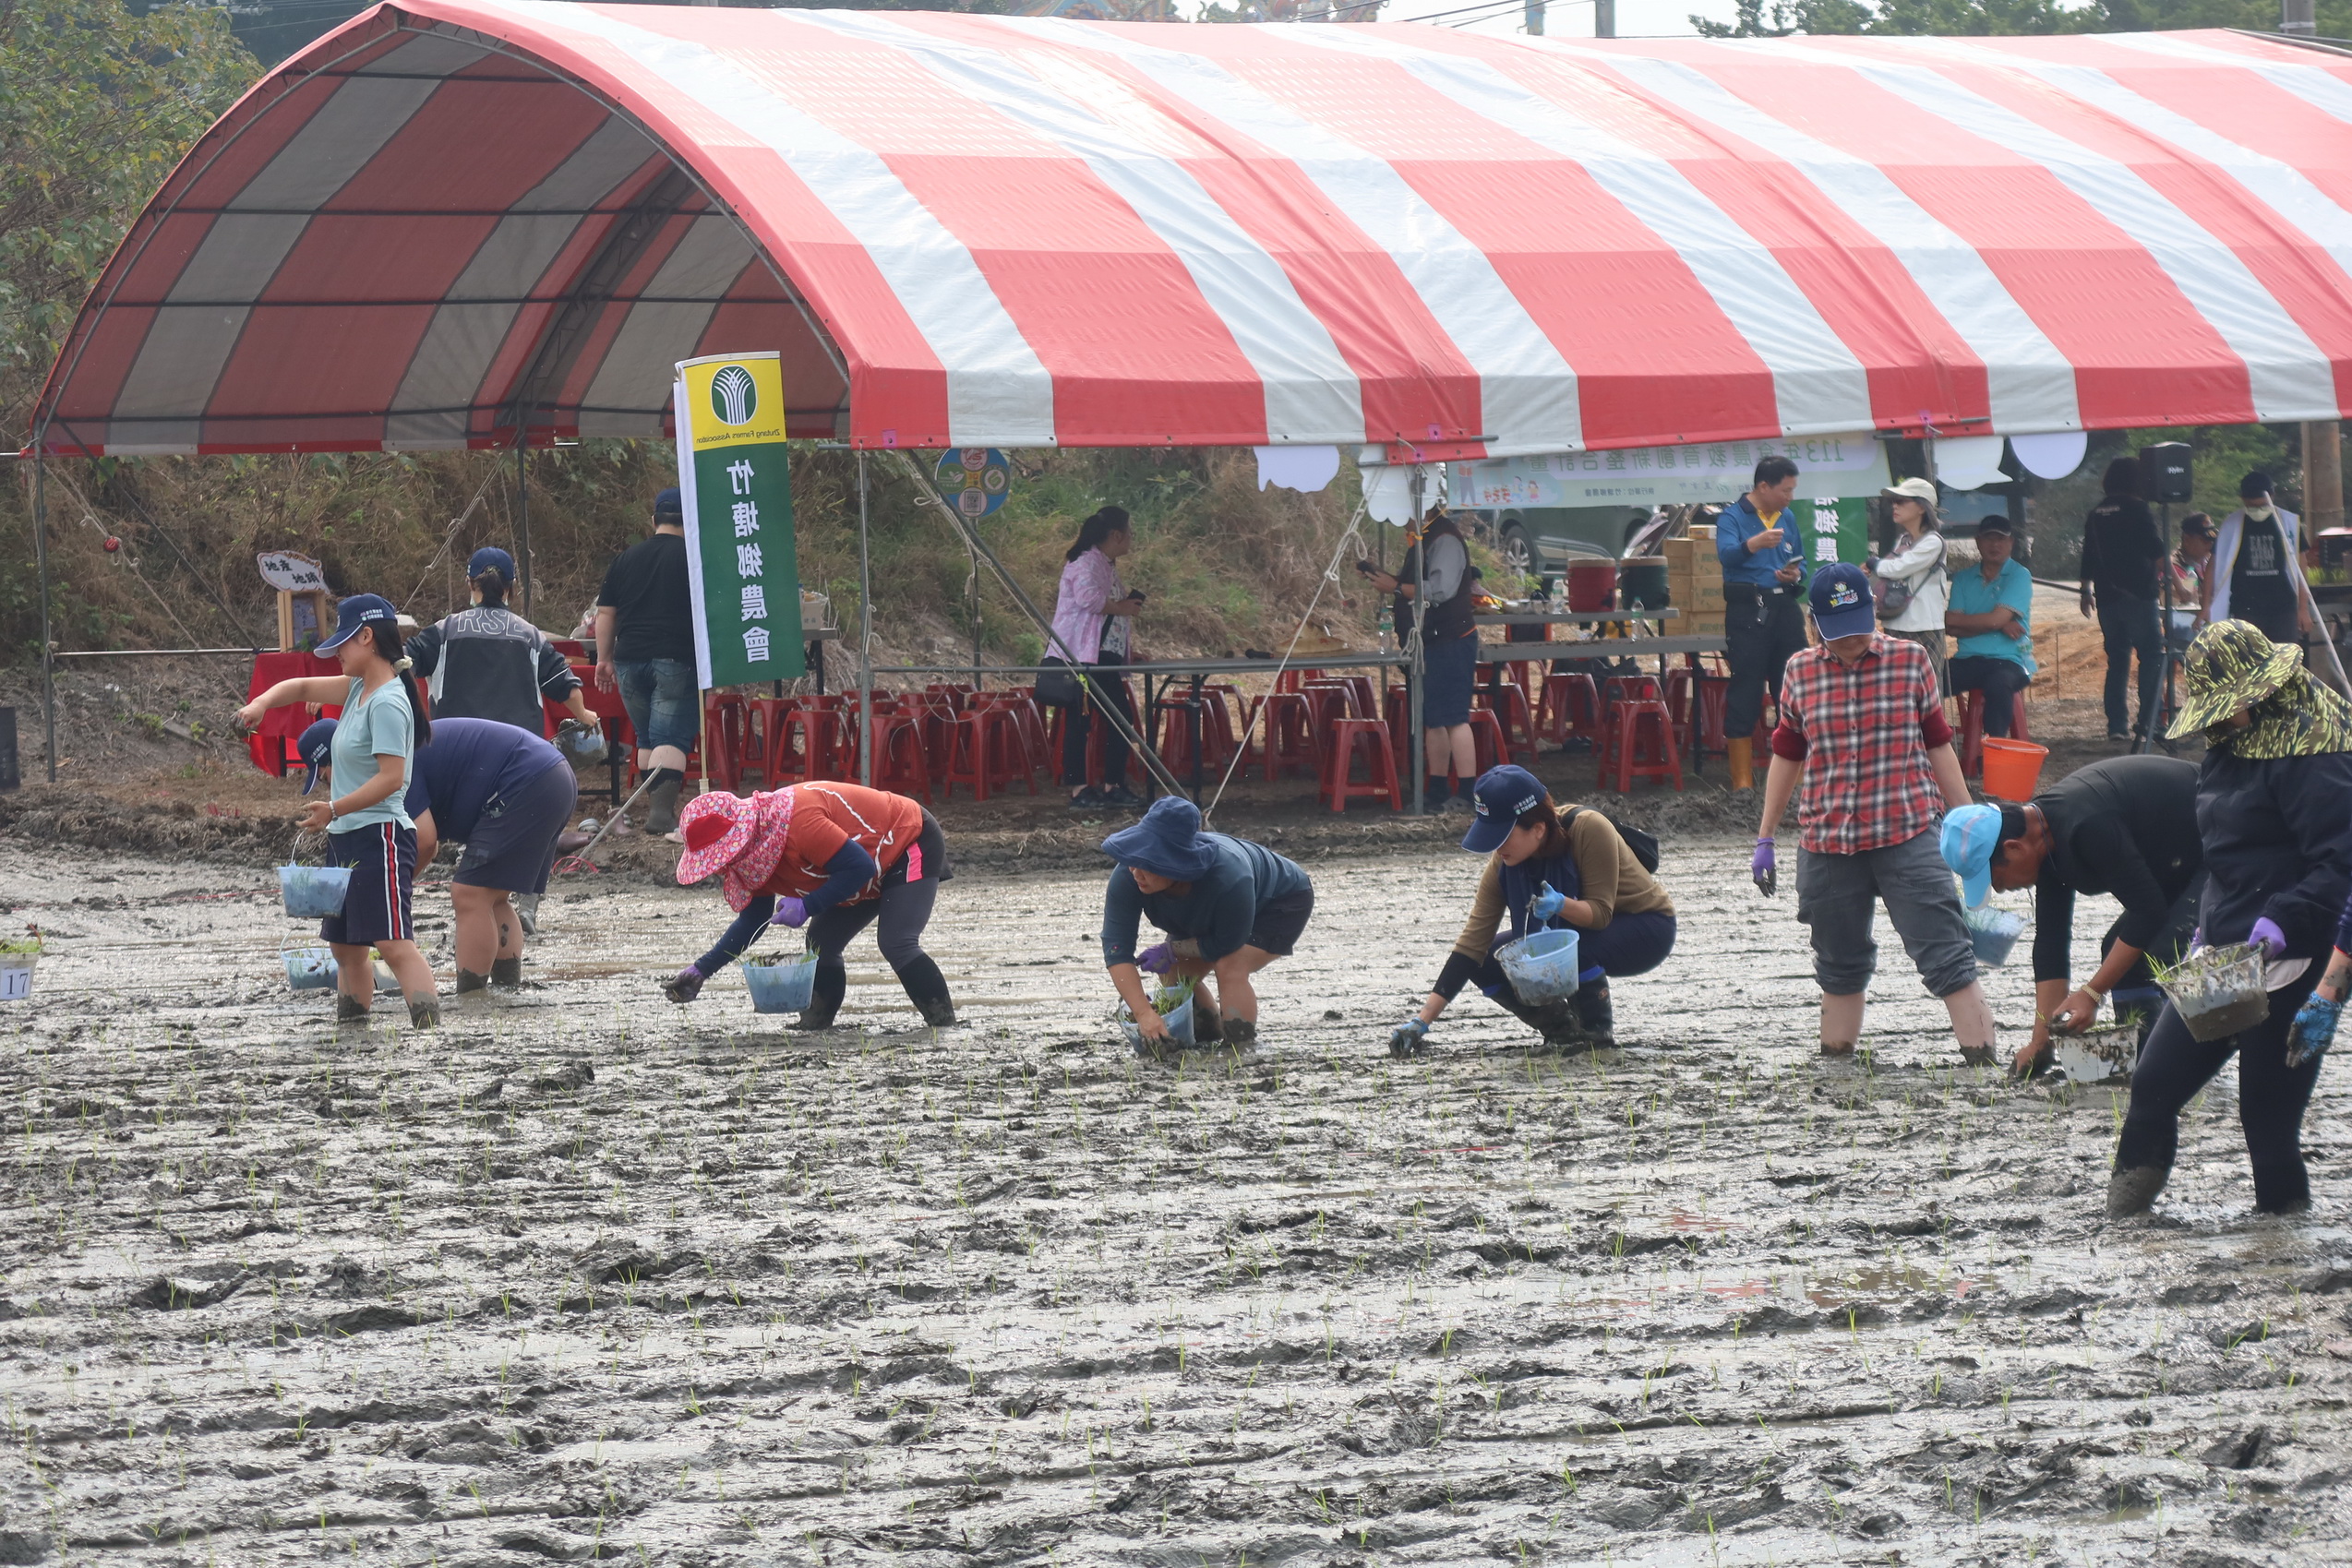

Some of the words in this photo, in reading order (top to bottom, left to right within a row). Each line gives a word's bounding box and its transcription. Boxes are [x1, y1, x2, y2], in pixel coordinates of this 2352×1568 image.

[264, 559, 293, 572] 地產
[292, 572, 320, 584] 地銷
[7, 972, 29, 995] 17
